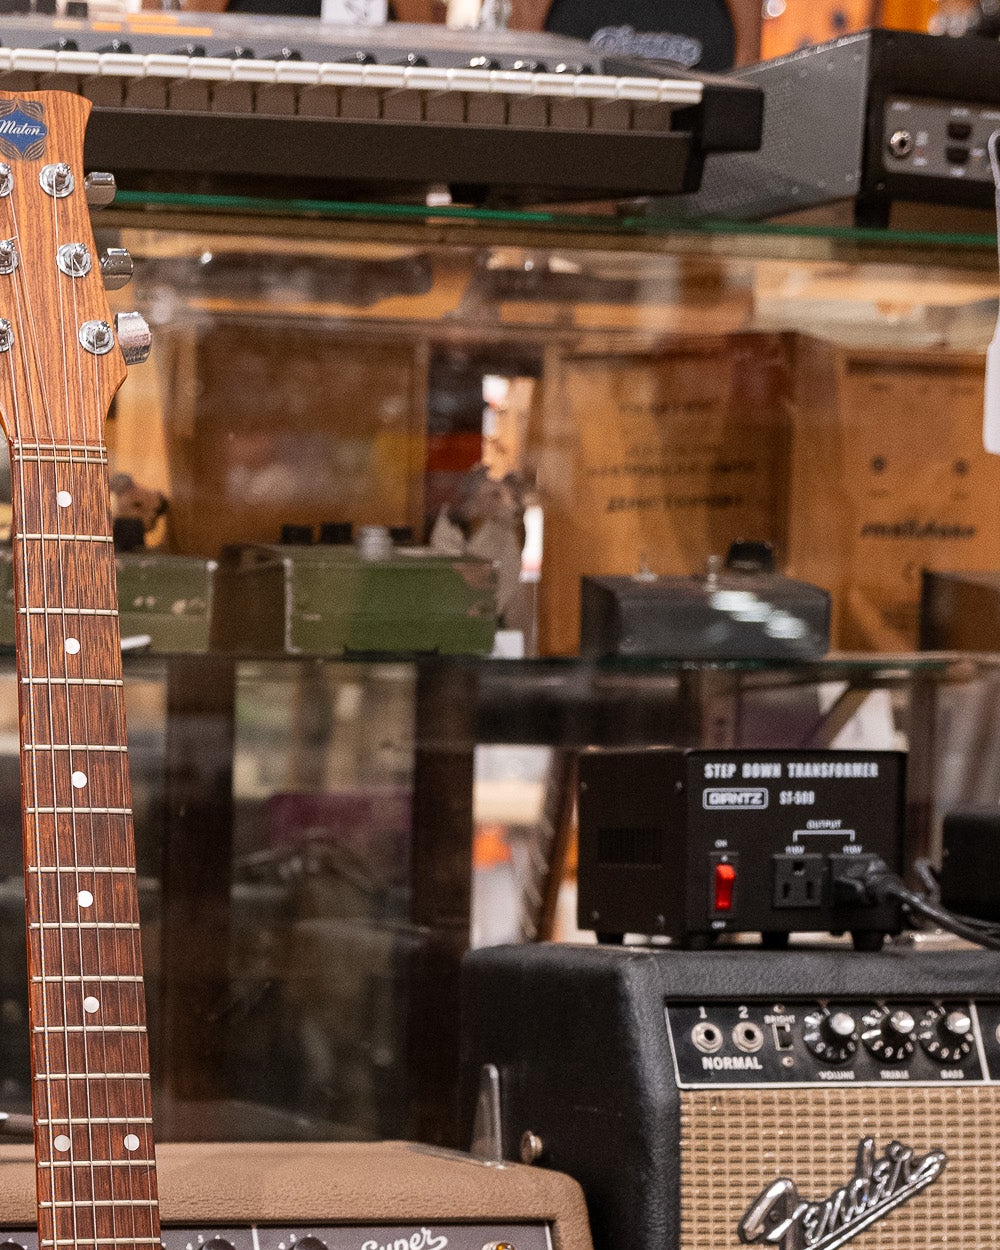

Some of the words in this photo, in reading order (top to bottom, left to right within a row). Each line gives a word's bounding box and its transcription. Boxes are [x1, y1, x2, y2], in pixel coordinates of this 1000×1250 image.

[704, 763, 737, 778] STEP
[742, 763, 782, 778] DOWN
[787, 762, 879, 778] TRANSFORMER
[806, 819, 842, 829] OUTPUT
[699, 1006, 707, 1019] 1
[738, 1006, 749, 1019] 2
[702, 1056, 763, 1070] NORMAL
[818, 1070, 856, 1080] VOLUME
[198, 1234, 204, 1244] 5
[290, 1233, 296, 1243] 5
[186, 1242, 193, 1250] 4
[278, 1242, 286, 1250] 4
